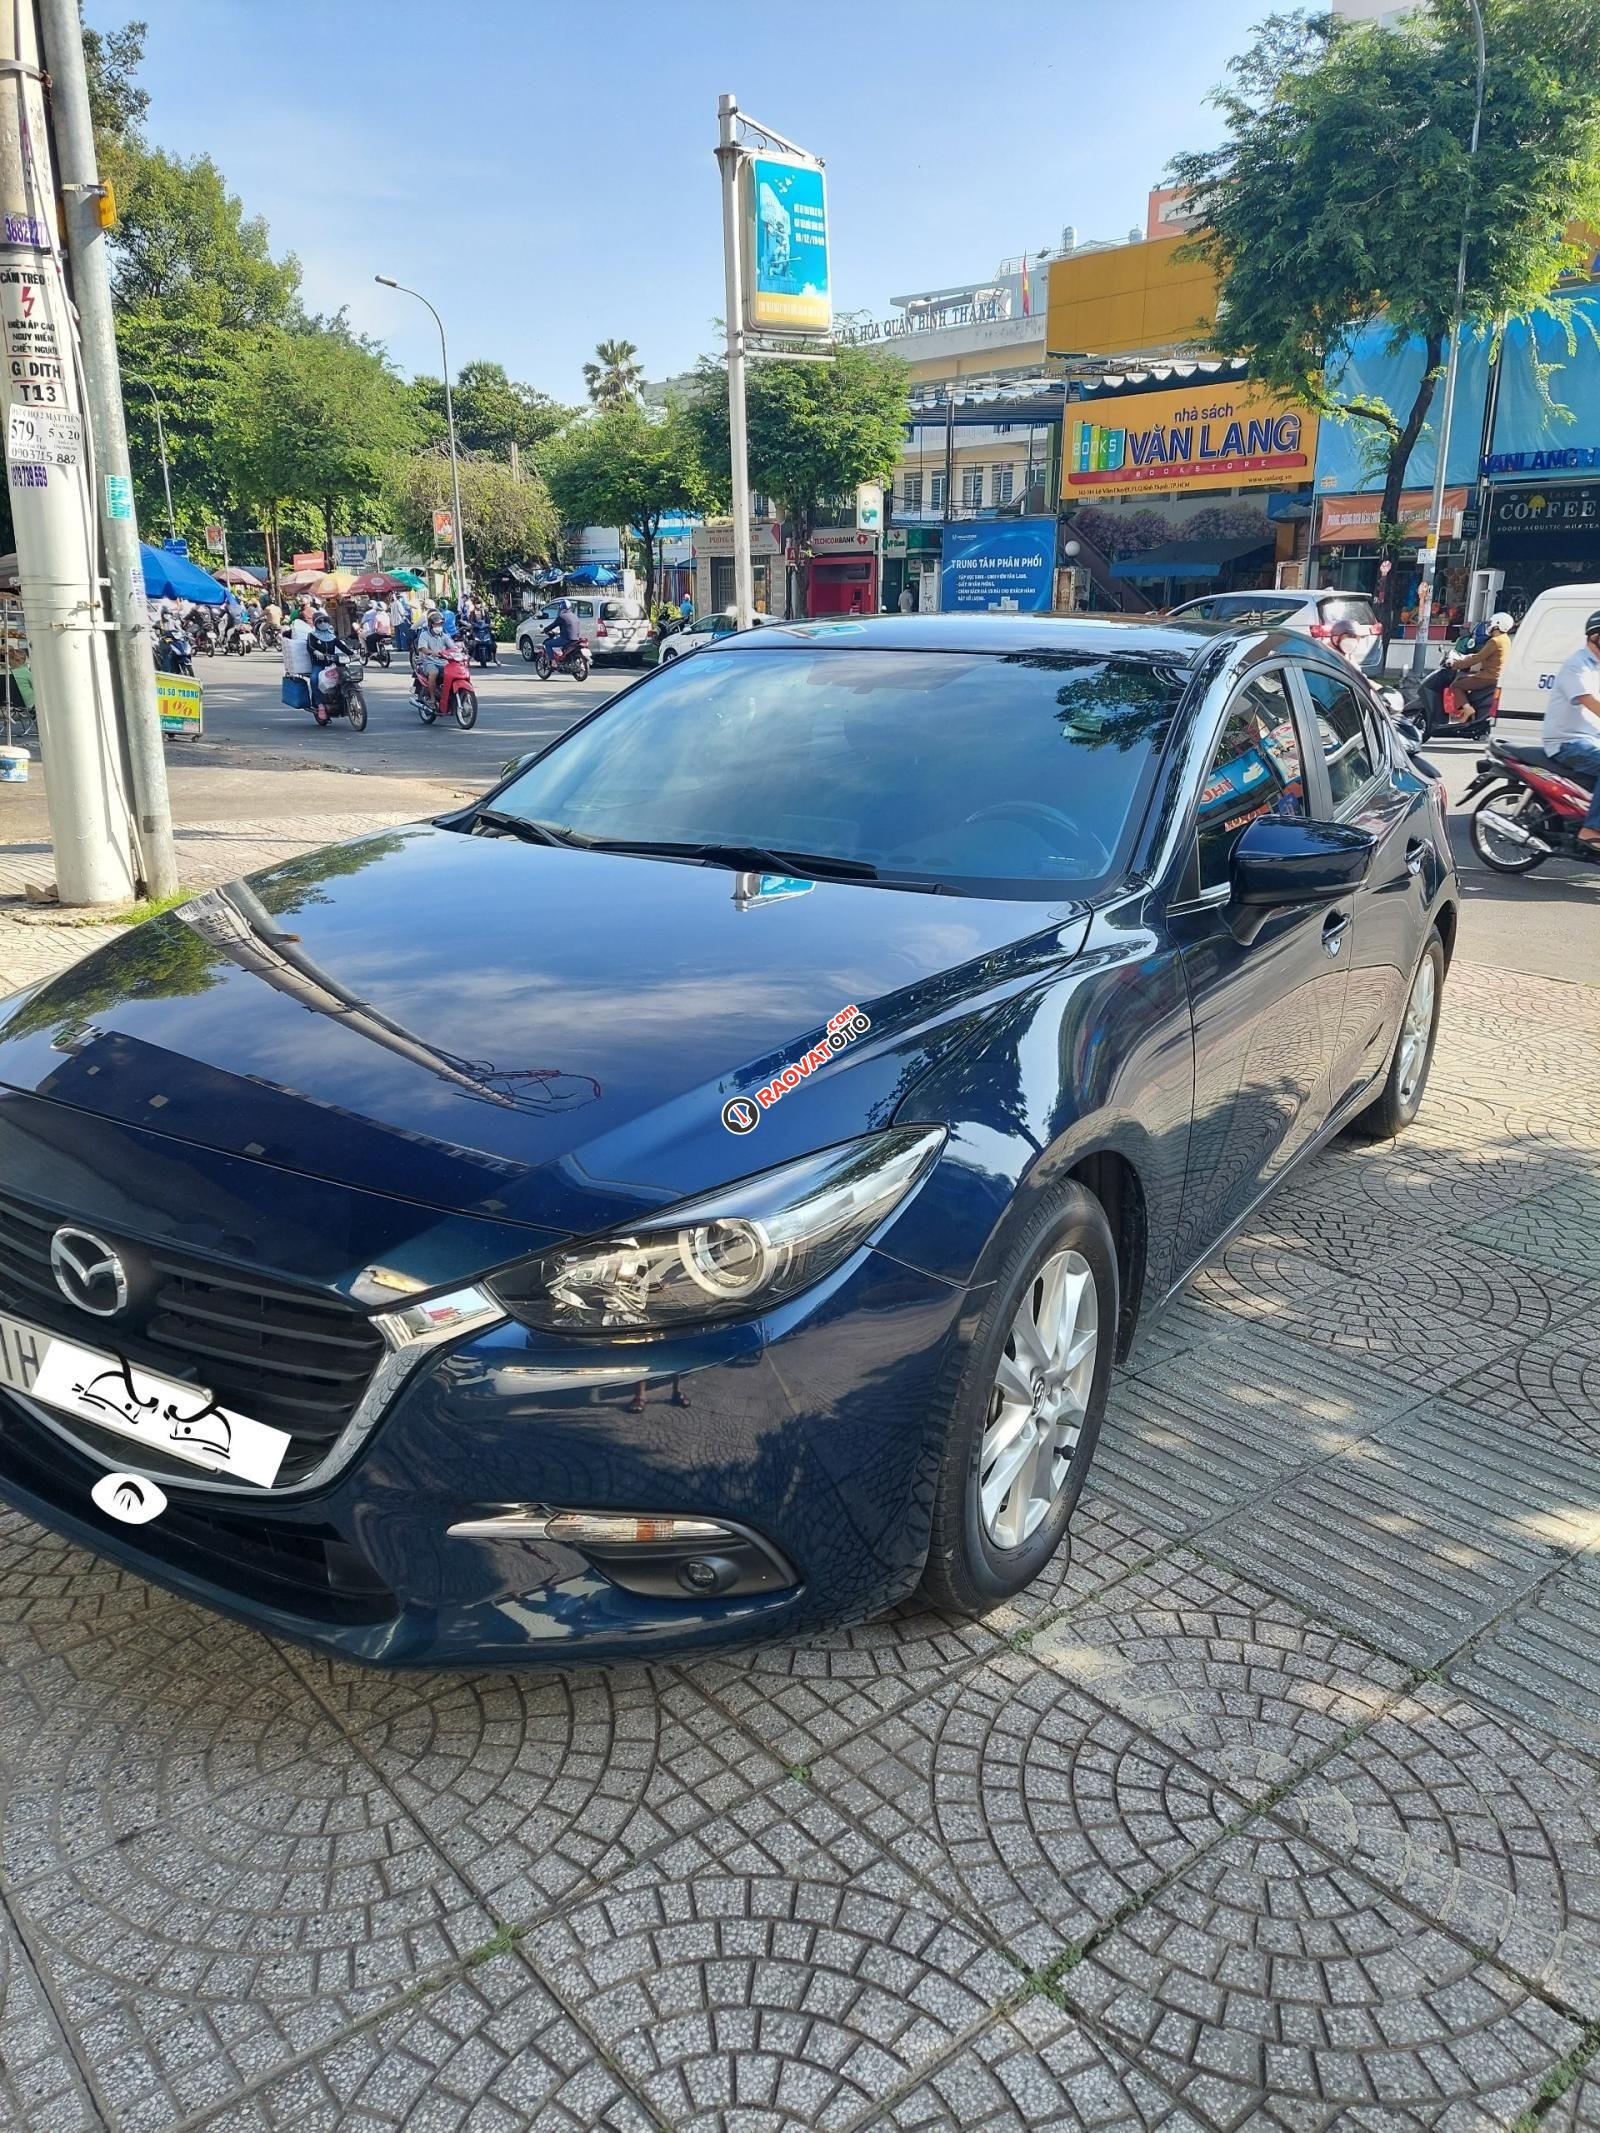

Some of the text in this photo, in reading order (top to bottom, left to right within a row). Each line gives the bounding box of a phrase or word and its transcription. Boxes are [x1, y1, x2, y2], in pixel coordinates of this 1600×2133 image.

[20, 384, 57, 402] T13
[1174, 402, 1233, 423] nhà sách
[11, 418, 35, 441] 579
[48, 428, 55, 438] 5
[68, 430, 80, 440] 20
[1073, 438, 1117, 456] BOOKS
[1128, 414, 1301, 466] VĂN LANG
[56, 453, 77, 464] 882
[1499, 500, 1597, 520] COFFEE
[814, 536, 855, 546] TECHCOMBANK
[952, 553, 1042, 569] TRUNG TÂM PHÂN PHỐI
[1538, 674, 1556, 690] 50
